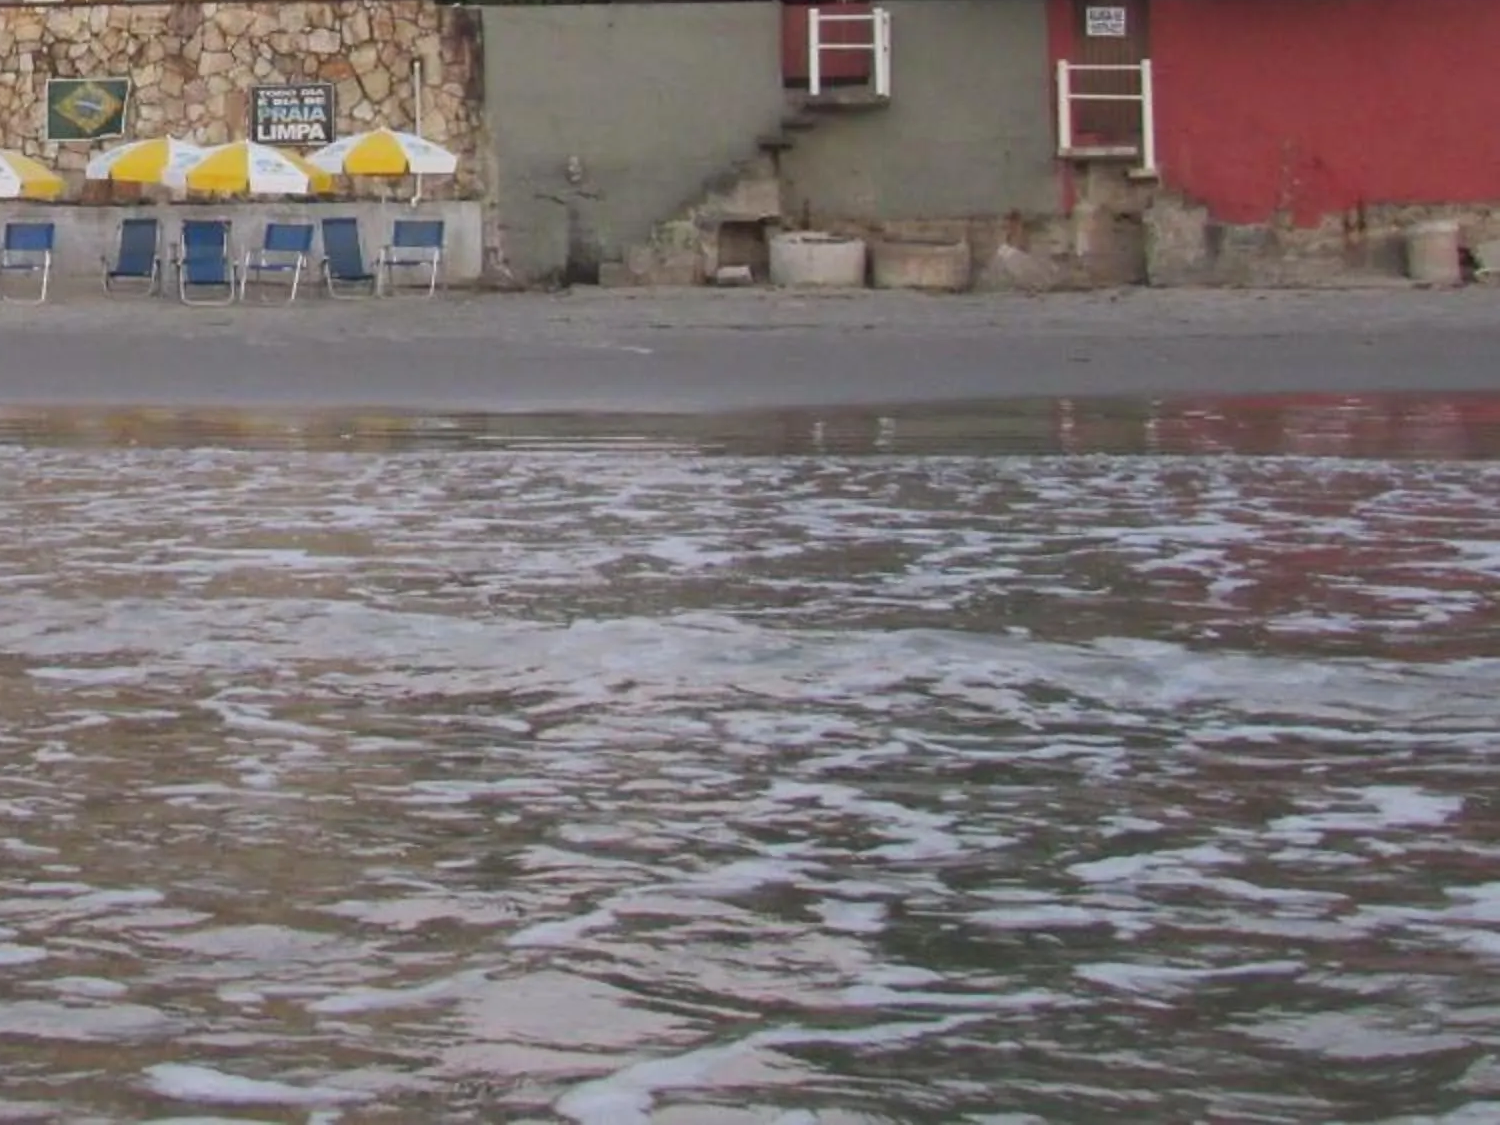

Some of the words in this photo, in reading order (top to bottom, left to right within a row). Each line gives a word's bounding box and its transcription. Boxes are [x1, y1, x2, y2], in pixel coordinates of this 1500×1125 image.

[300, 88, 325, 96] DIA
[273, 98, 300, 106] DIA
[303, 96, 326, 105] DE
[257, 106, 326, 123] PRAIA
[257, 122, 326, 141] LIMPA
